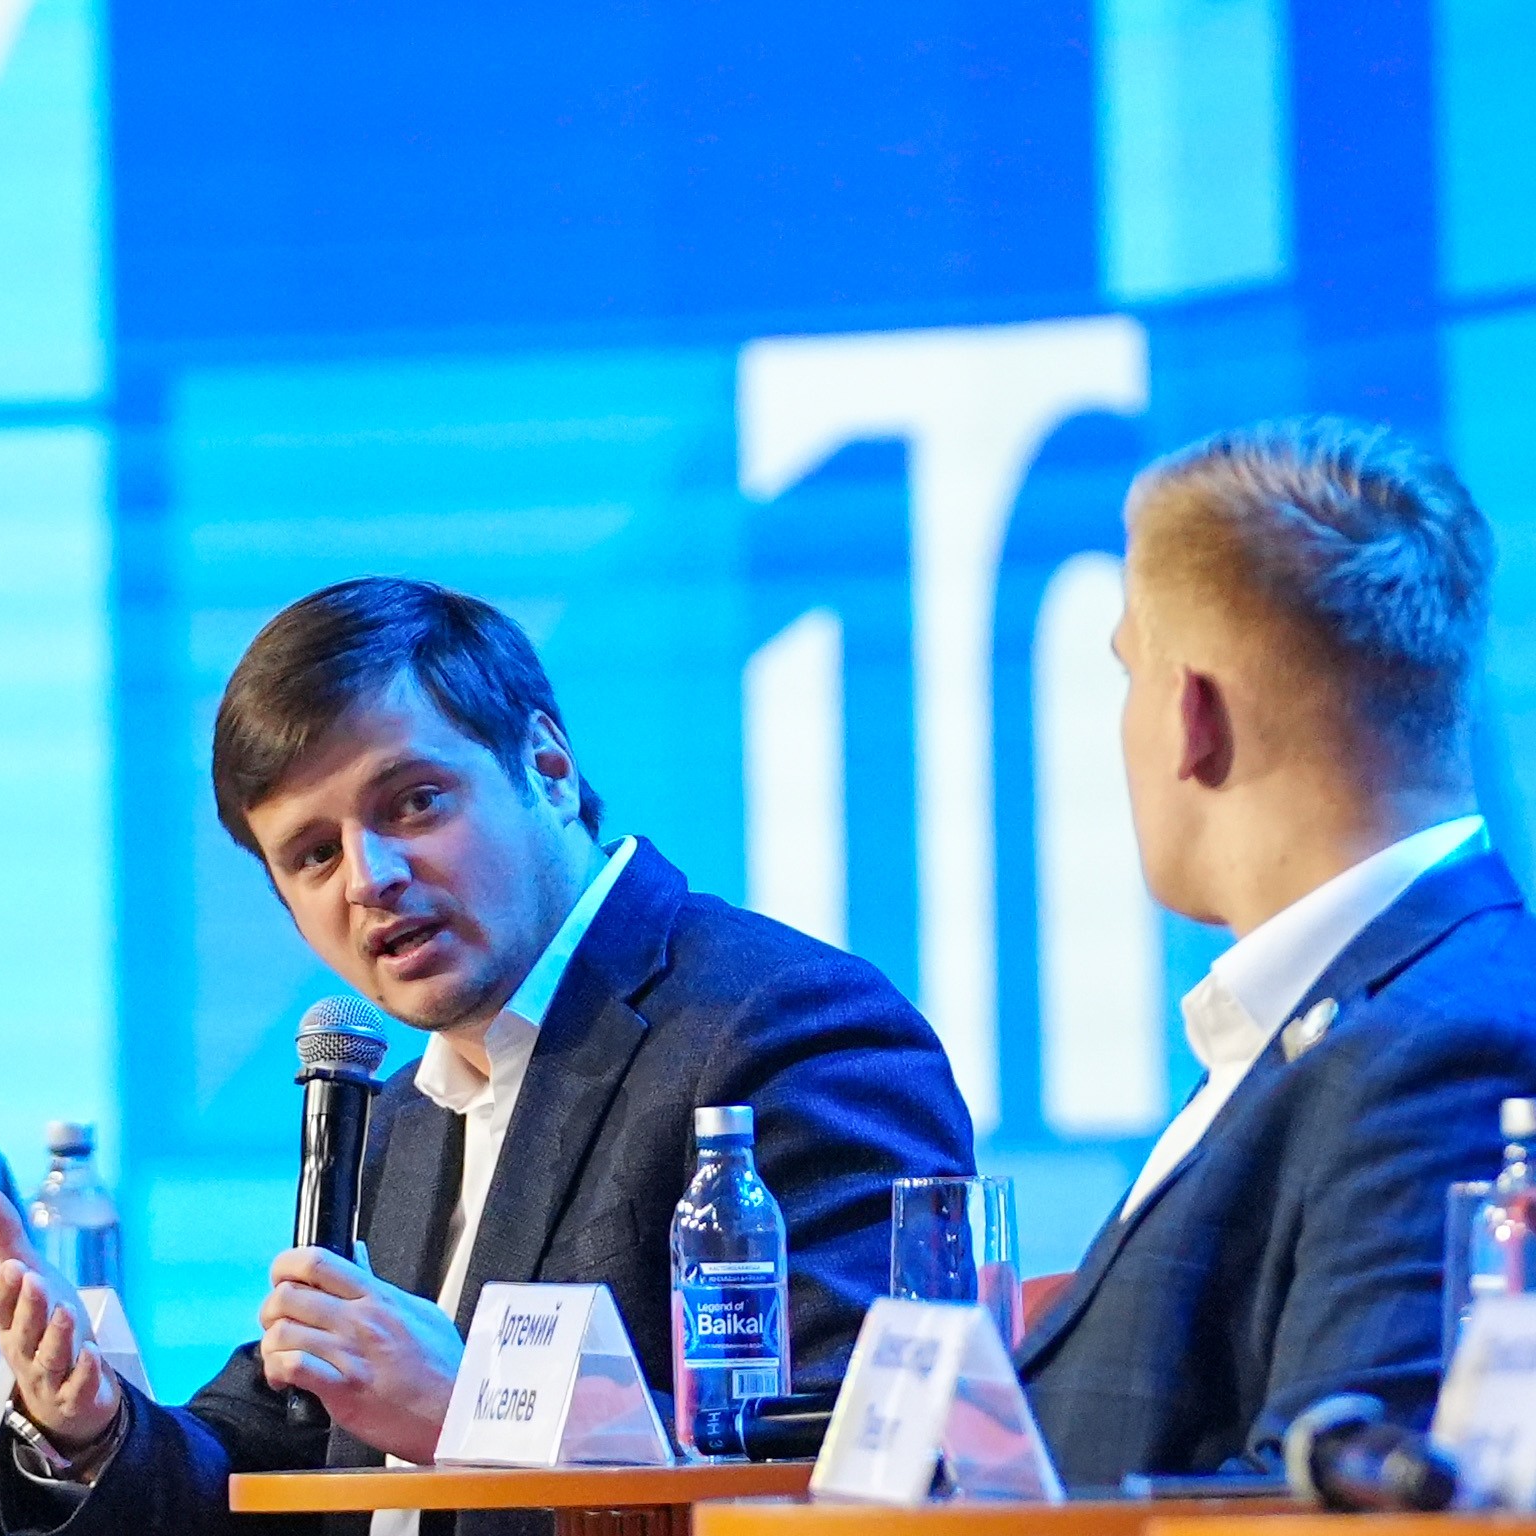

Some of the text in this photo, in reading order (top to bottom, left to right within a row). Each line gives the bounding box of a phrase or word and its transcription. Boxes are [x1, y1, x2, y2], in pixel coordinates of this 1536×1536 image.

[697, 1301, 744, 1313] Legend of
[494, 1300, 562, 1356] Артемий
[697, 1313, 764, 1335] Baikal
[474, 1377, 537, 1421] Киселев
